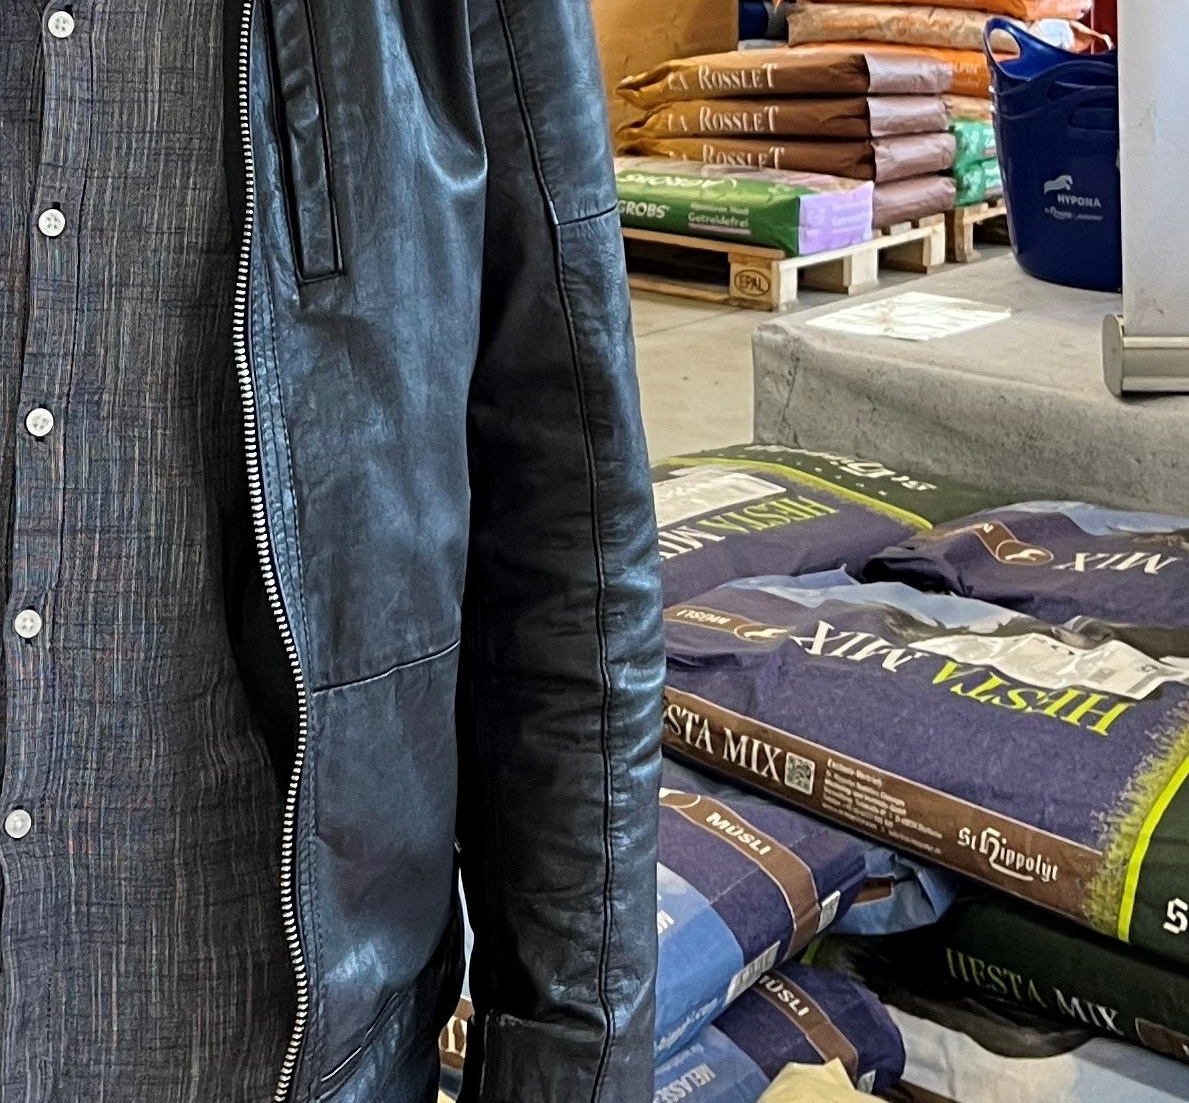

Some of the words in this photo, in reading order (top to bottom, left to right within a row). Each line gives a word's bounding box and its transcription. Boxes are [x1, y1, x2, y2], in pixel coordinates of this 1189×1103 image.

[617, 199, 668, 219] GROBS
[1057, 193, 1102, 208] HYPONA
[696, 495, 841, 535] HESTA
[1051, 551, 1183, 575] MIX
[787, 619, 931, 674] MIX
[931, 659, 1137, 737] HESTA
[663, 703, 714, 755] STA
[722, 726, 783, 783] MIX
[705, 811, 772, 855] MÜSLI
[945, 946, 1049, 1009] HESTA
[1053, 986, 1125, 1037] MIX
